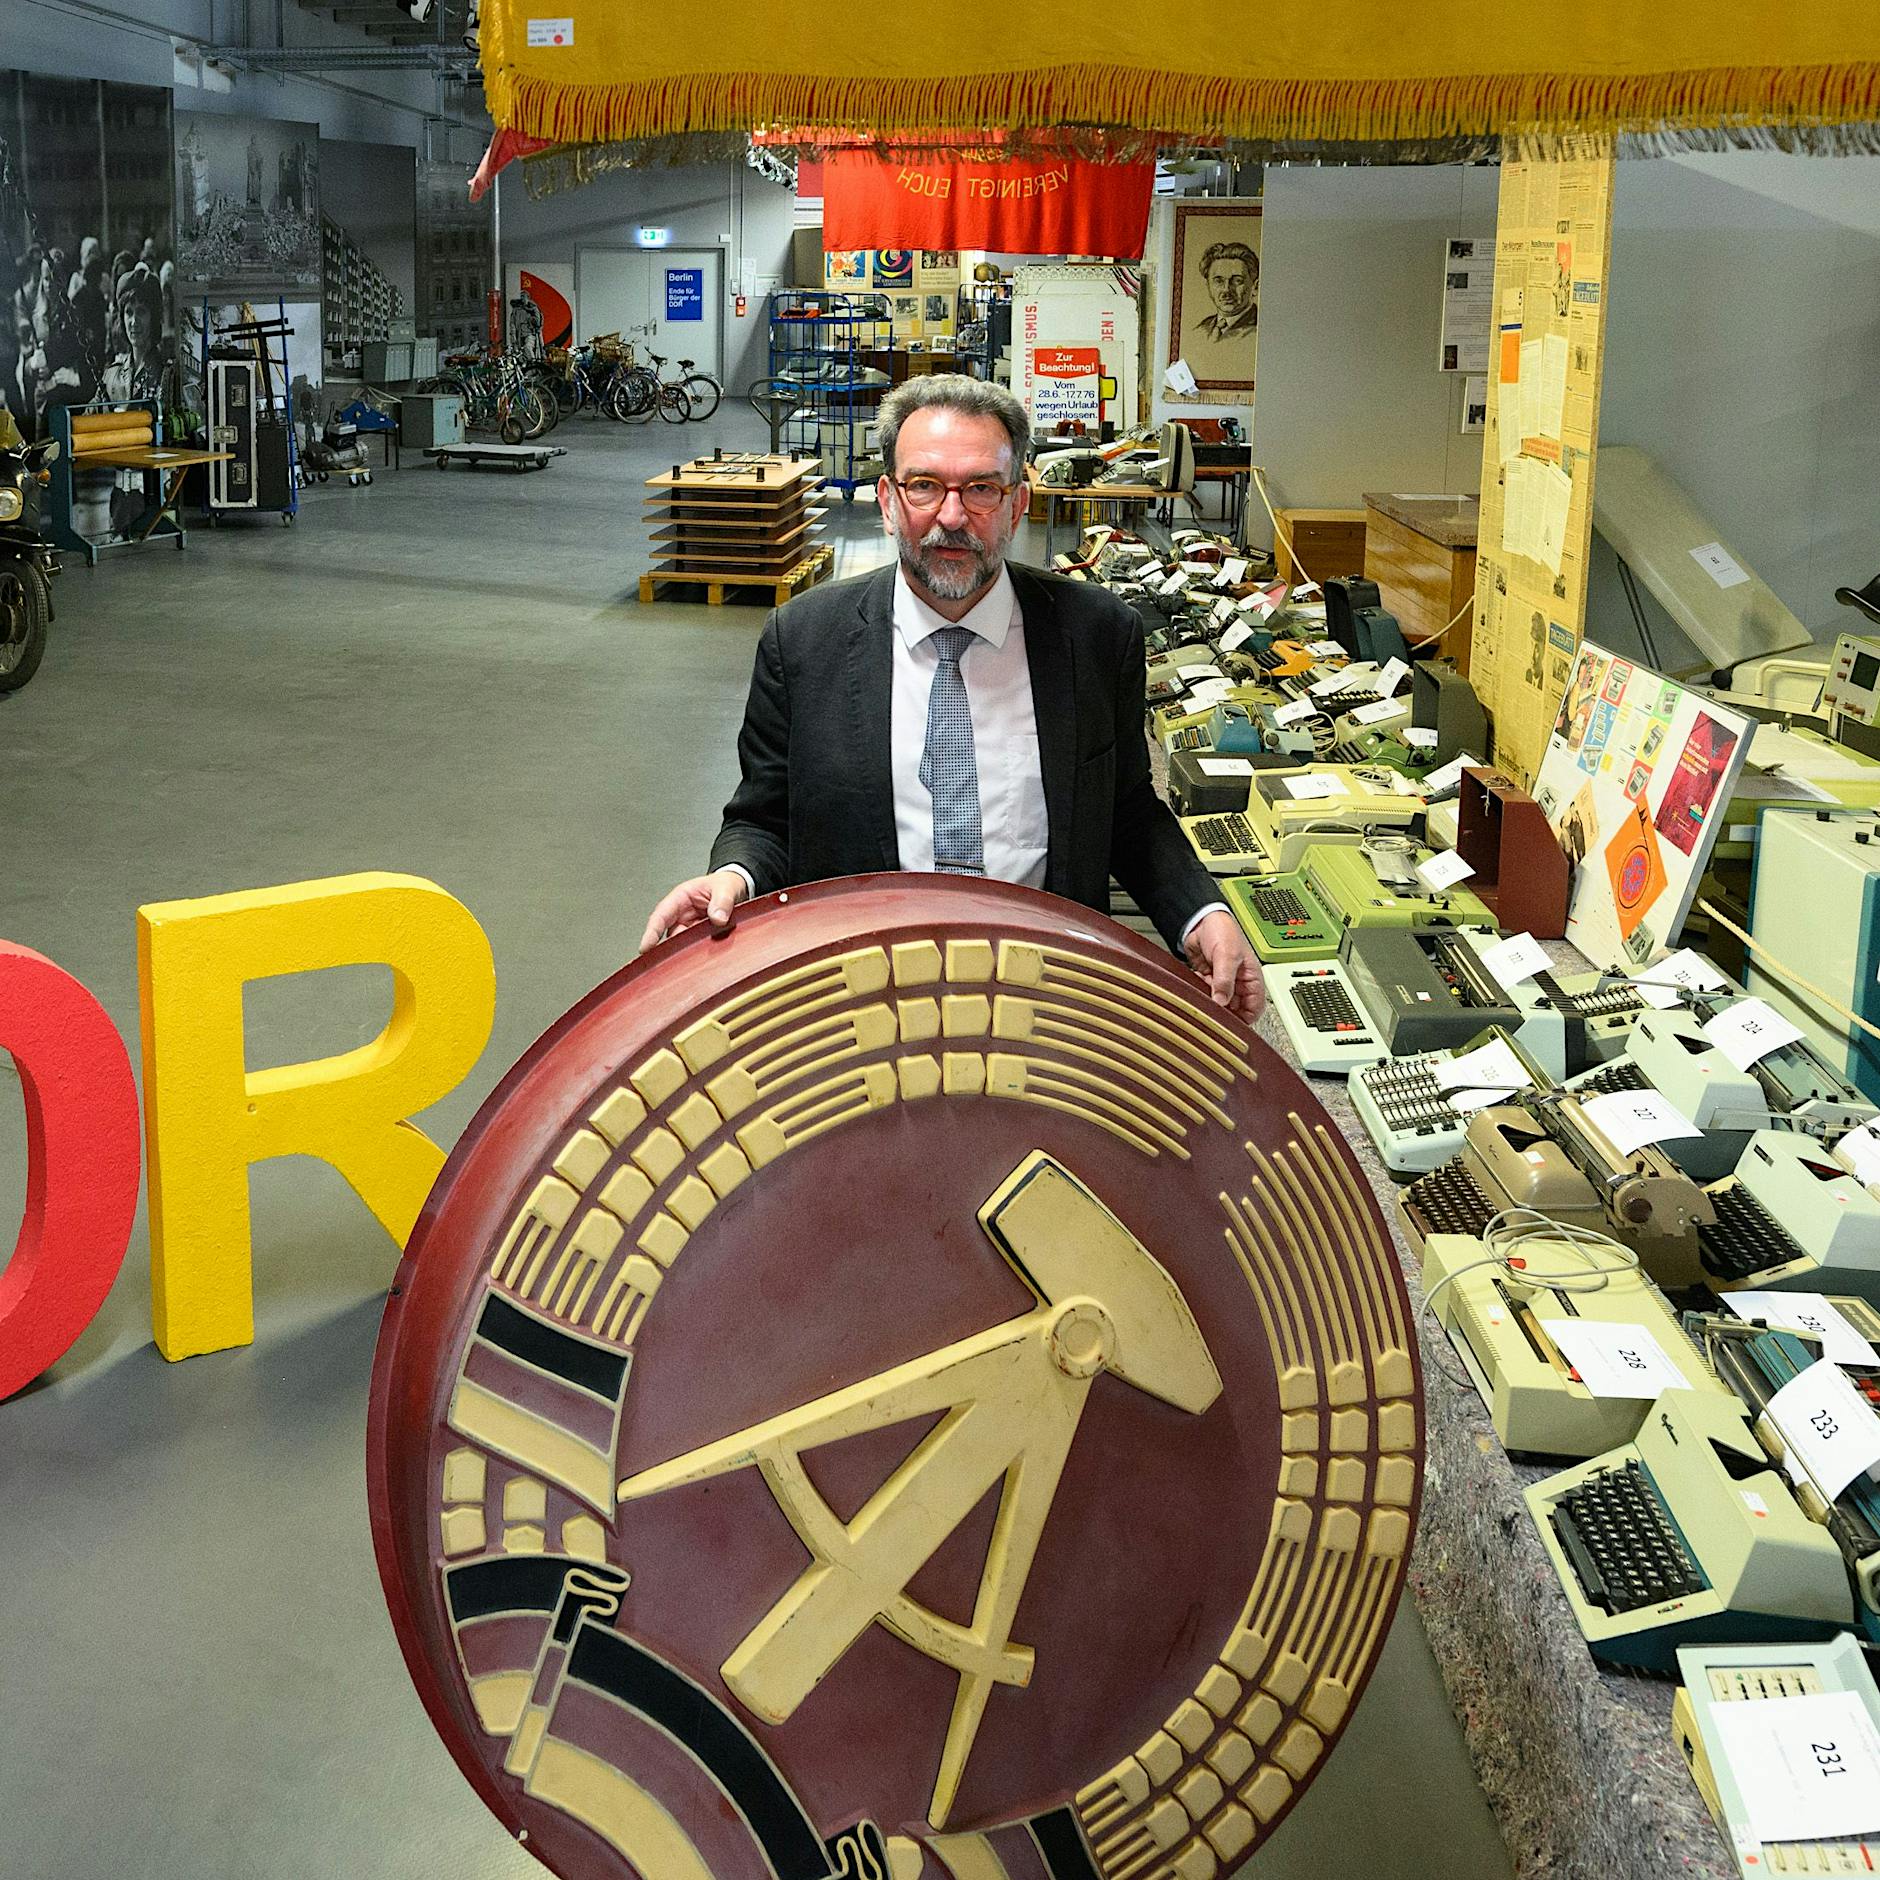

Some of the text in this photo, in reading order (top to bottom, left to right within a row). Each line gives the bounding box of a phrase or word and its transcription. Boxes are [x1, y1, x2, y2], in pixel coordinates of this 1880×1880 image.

[669, 273, 693, 282] Berlin
[1055, 352, 1074, 362] Zur
[1039, 362, 1095, 373] Beachtung!
[1054, 381, 1076, 389] Vom
[1035, 401, 1098, 411] wegen Urlaub
[1037, 411, 1098, 420] geschlossen.
[1674, 970, 1692, 983] 221
[1741, 1020, 1763, 1034] 224
[1633, 1107, 1657, 1121] 227
[1797, 1314, 1826, 1333] 230
[1618, 1348, 1647, 1370] 228
[1810, 1409, 1839, 1440] 233
[1811, 1741, 1847, 1778] 231
